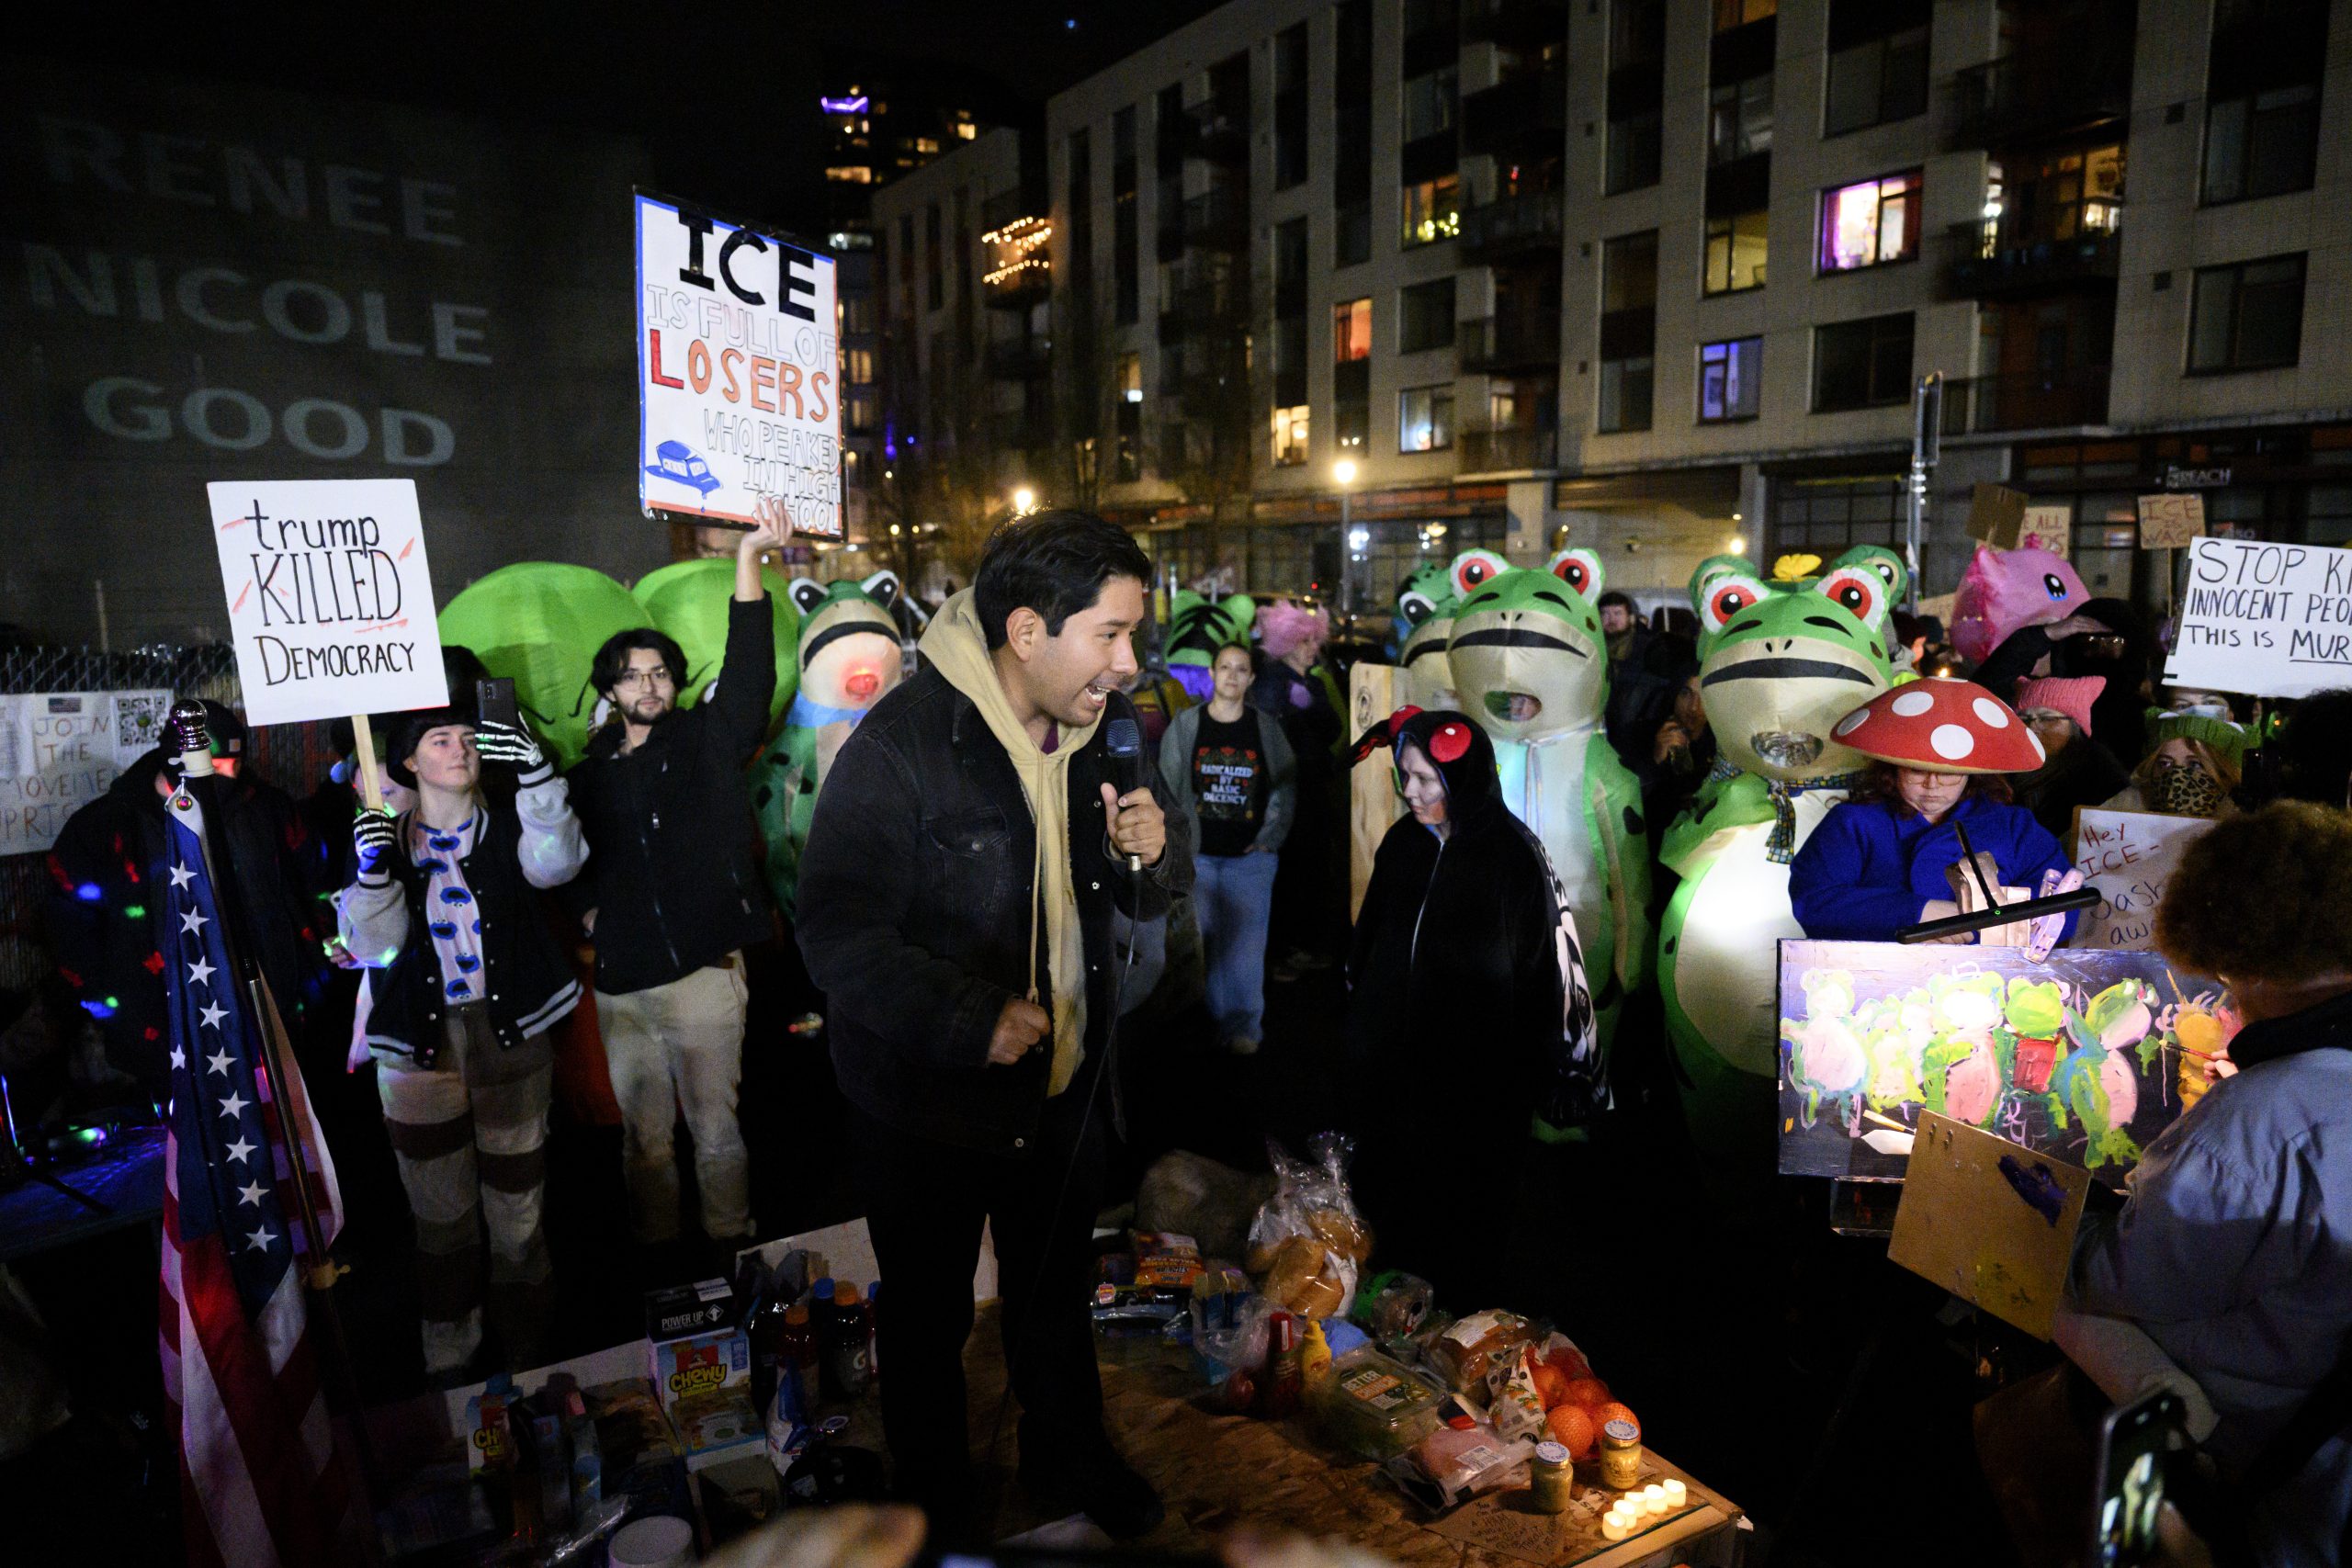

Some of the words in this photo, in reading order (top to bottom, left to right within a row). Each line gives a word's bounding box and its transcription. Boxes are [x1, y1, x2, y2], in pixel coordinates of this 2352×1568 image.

[36, 111, 466, 246] RENEE
[678, 209, 816, 323] ICE
[22, 242, 493, 365] NICOLE
[646, 284, 692, 329] IS
[697, 296, 793, 362] FULL
[795, 325, 837, 372] OF
[650, 328, 831, 423] LOSERS
[83, 376, 457, 467] GOOD
[704, 408, 753, 457] WHO
[758, 420, 840, 476] PEAKED
[743, 455, 777, 493] IN
[783, 460, 842, 505] HIGH
[244, 499, 379, 558] trump
[2198, 540, 2307, 586] STOP
[250, 549, 401, 626] KILLED
[2189, 586, 2294, 622] INNOCENT
[2305, 593, 2352, 626] PEO
[253, 635, 415, 686] DEMOCRACY
[2184, 625, 2241, 648] THIS
[2254, 630, 2275, 649] IS
[2289, 628, 2350, 661] MUR
[36, 716, 109, 738] JOIN
[43, 742, 93, 764] THE
[2084, 823, 2125, 848] Hey
[2081, 843, 2140, 881] ICE
[2110, 922, 2151, 945] aw
[661, 1313, 691, 1331] POWER
[693, 1310, 705, 1324] UP
[669, 1363, 728, 1393] CHEWY
[473, 1424, 502, 1450] CH
